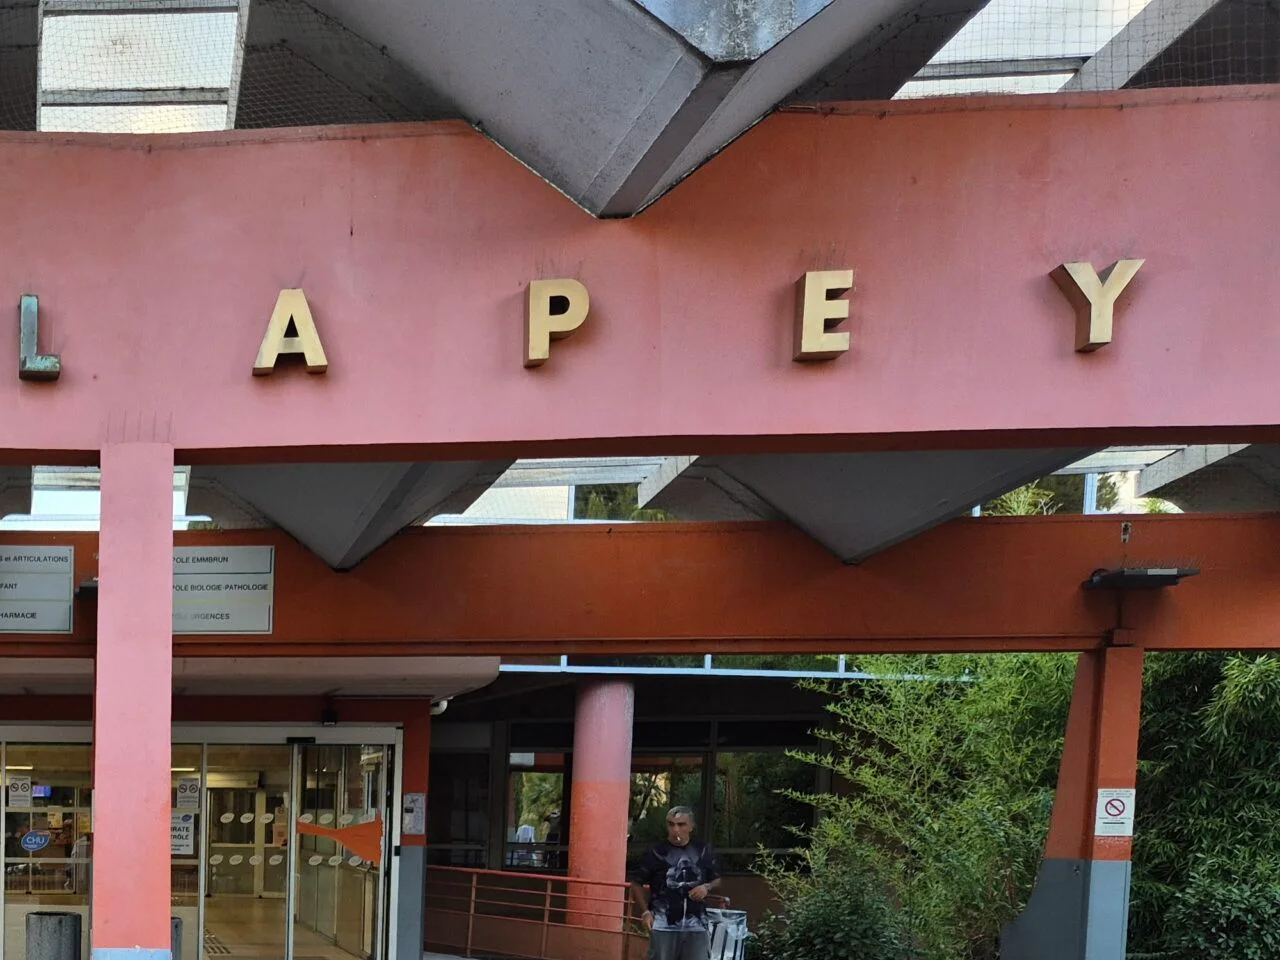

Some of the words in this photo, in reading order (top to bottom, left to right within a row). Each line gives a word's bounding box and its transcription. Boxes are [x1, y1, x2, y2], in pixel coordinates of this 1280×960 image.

[13, 555, 69, 563] ARTICULATIONS
[190, 584, 269, 592] BIOLOGIE-PATHOLOGIE
[26, 836, 45, 844] CHU
